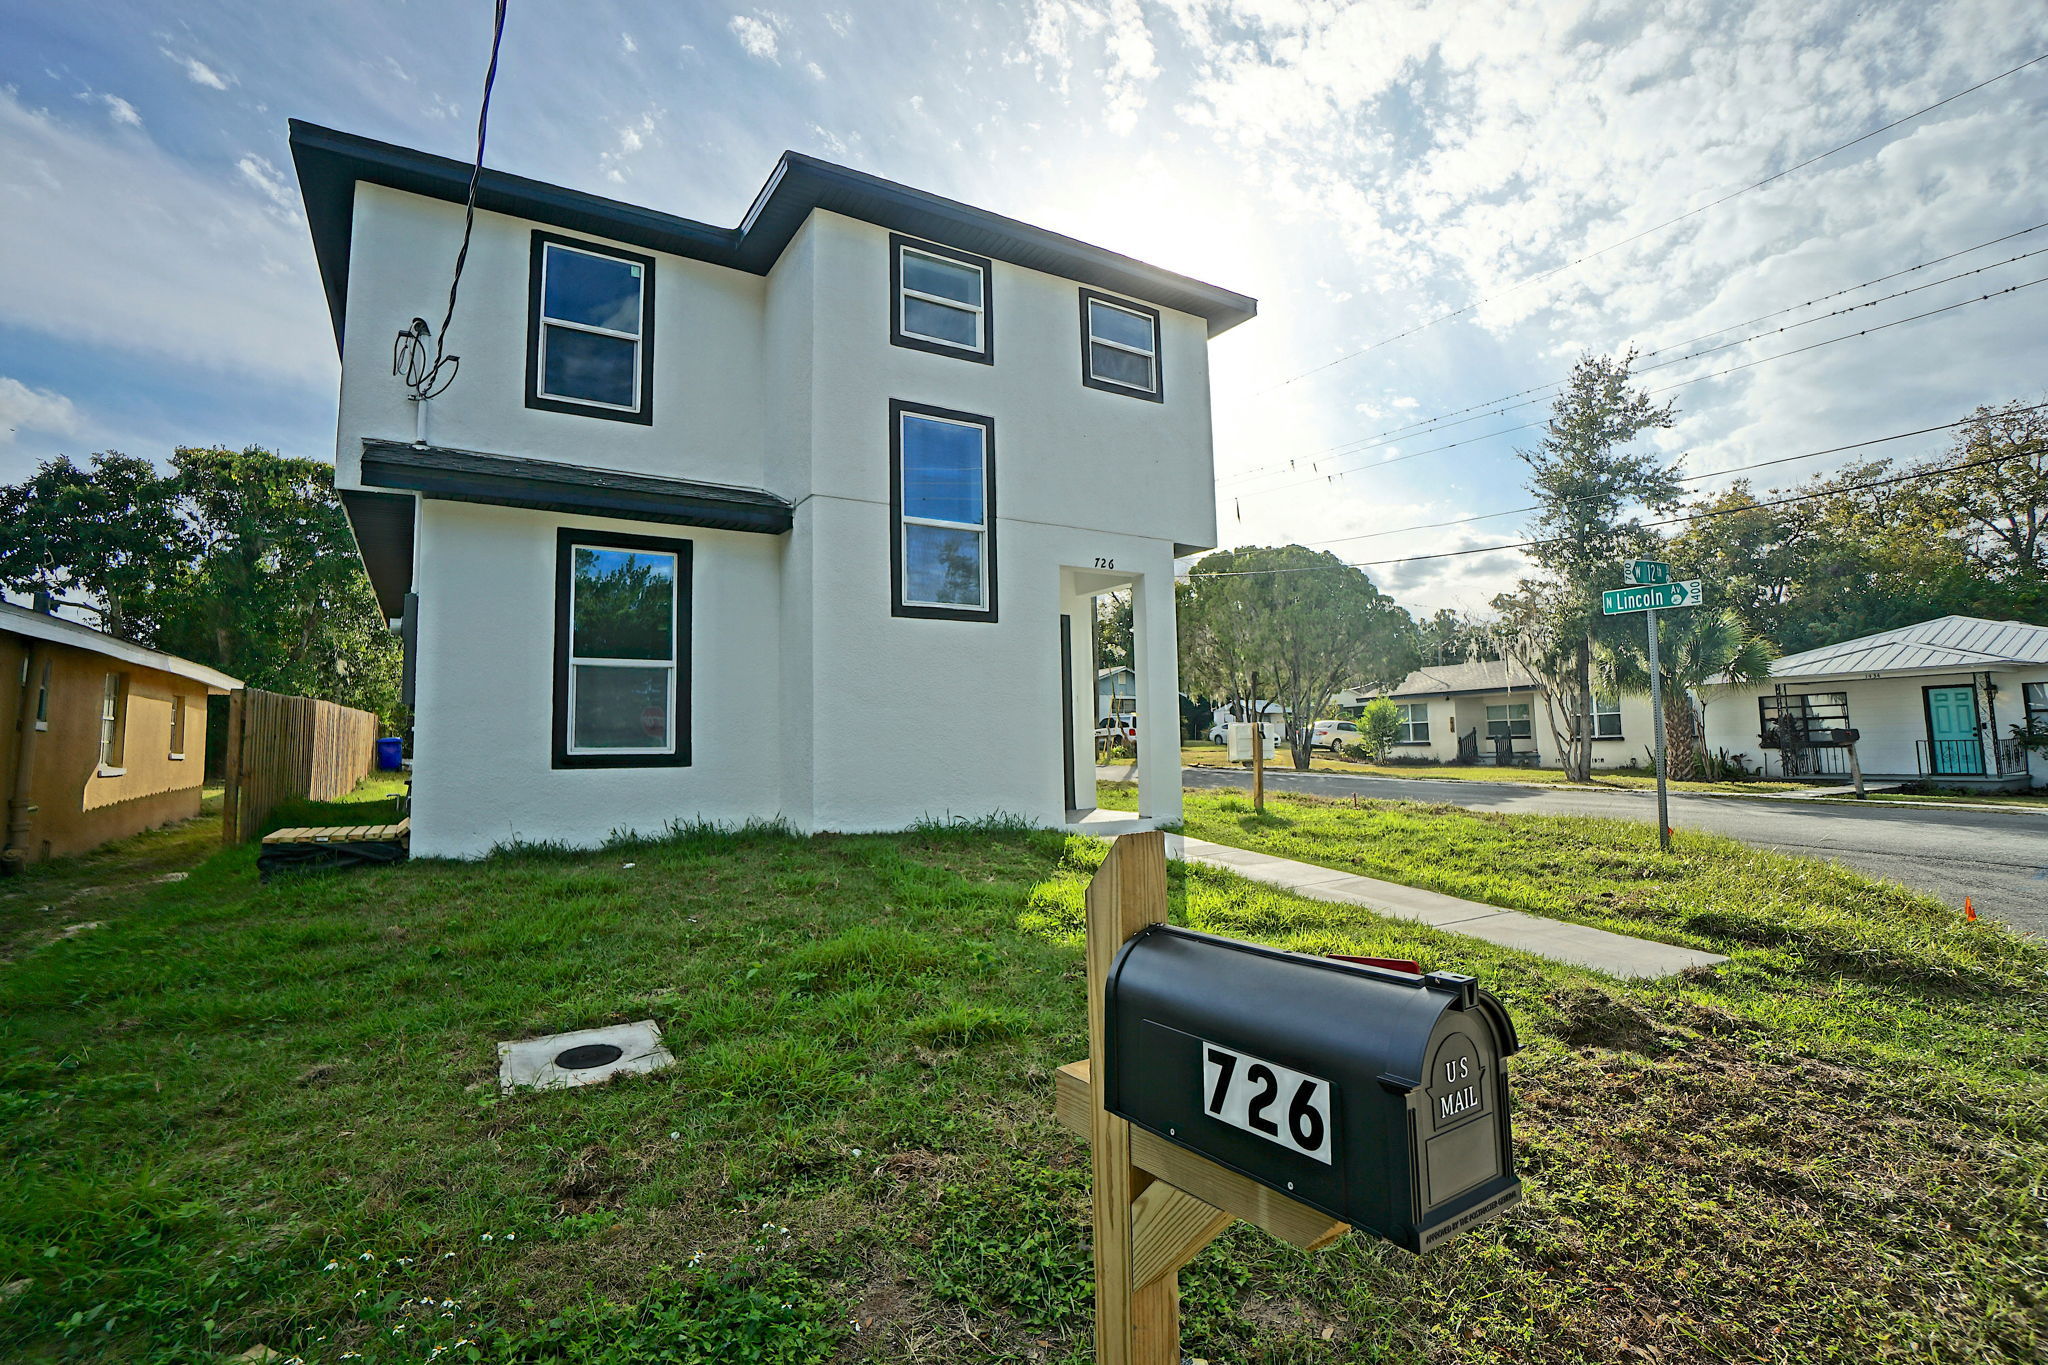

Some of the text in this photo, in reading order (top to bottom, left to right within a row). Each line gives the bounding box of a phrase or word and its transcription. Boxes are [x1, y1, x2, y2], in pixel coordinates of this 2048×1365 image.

[1094, 557, 1114, 570] 726
[1624, 562, 1632, 581] 700
[1635, 566, 1641, 578] W
[1606, 597, 1613, 609] N
[1616, 589, 1664, 610] Lincoln
[1691, 581, 1701, 604] 1400
[1207, 1047, 1325, 1152] 726
[1440, 1085, 1479, 1119] MAIL
